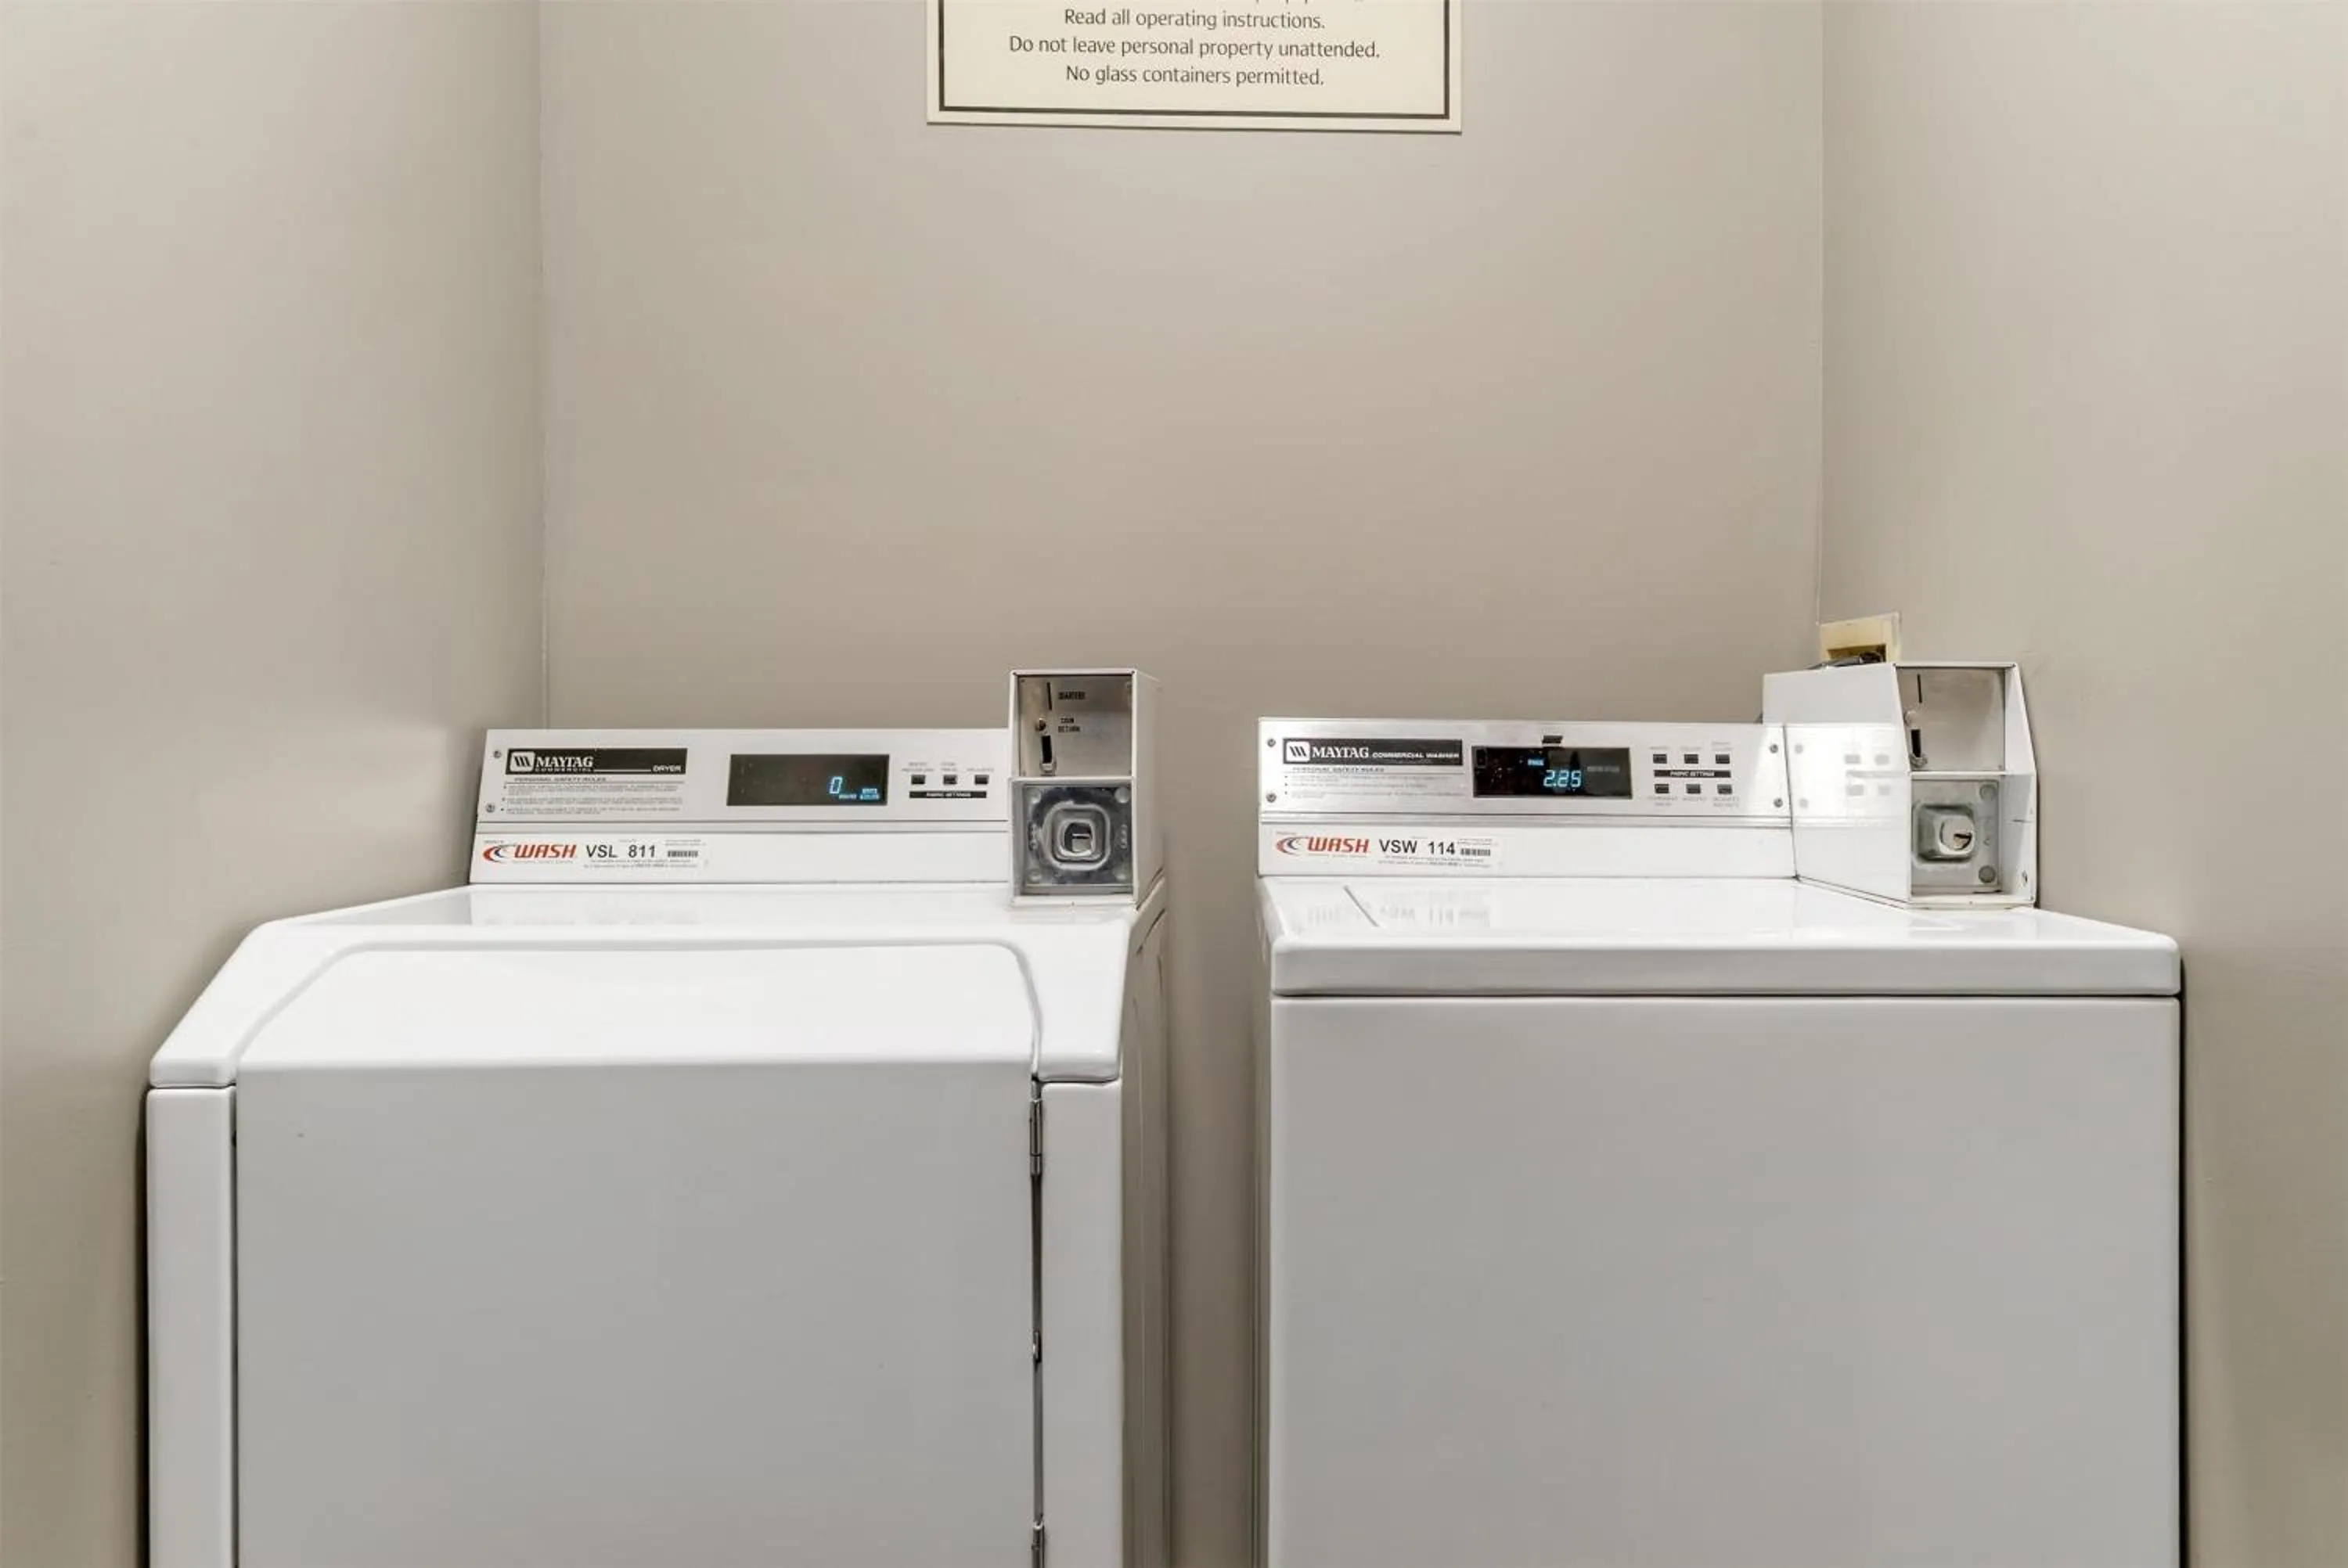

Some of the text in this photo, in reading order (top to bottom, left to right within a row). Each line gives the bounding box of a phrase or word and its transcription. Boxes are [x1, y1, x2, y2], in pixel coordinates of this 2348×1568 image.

[1064, 9, 1325, 31] Read all operating instructions.
[1009, 35, 1381, 60] Do not leave personal property unattended.
[1065, 65, 1324, 87] No glass containers permitted.
[1312, 746, 1369, 758] MAYTAG
[535, 757, 594, 768] MAYTAG
[515, 844, 577, 858] WASH
[586, 845, 655, 858] VSL 811
[1308, 837, 1370, 854] WASH
[1379, 839, 1417, 854] VSW
[1428, 842, 1455, 855] 114
